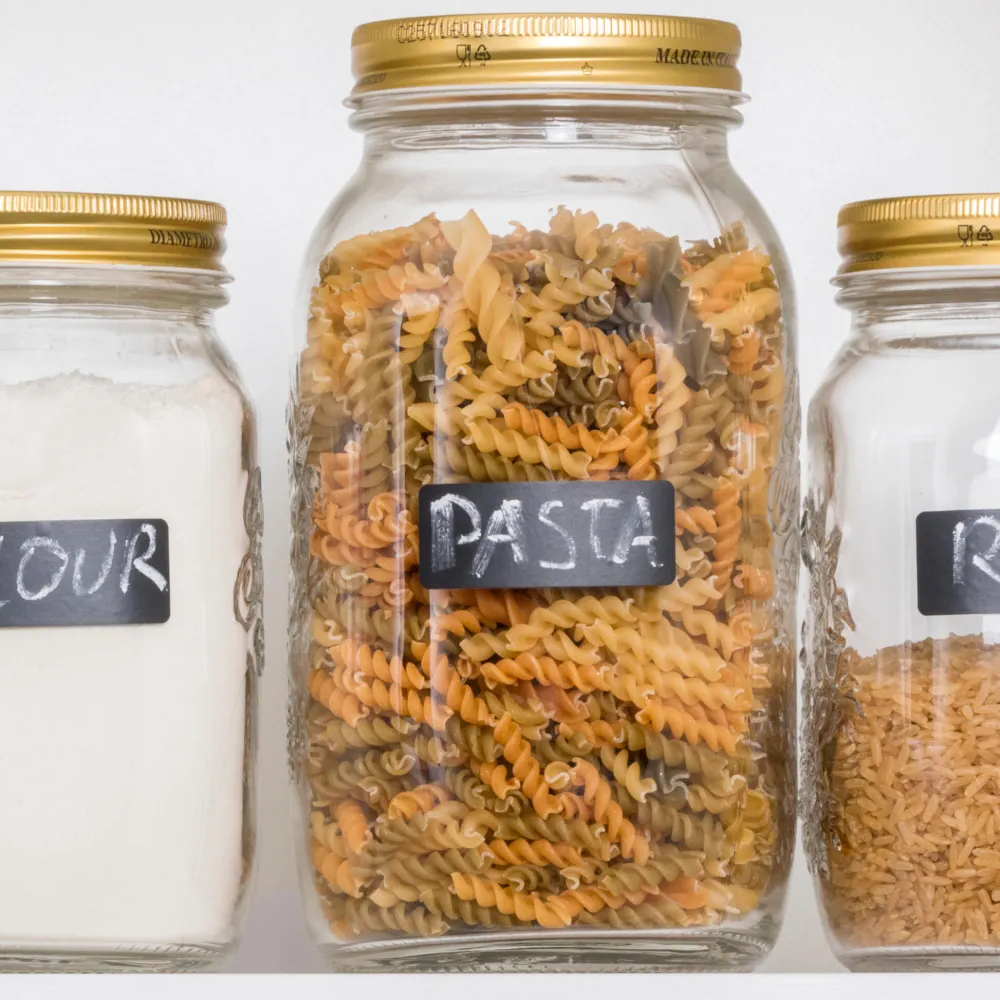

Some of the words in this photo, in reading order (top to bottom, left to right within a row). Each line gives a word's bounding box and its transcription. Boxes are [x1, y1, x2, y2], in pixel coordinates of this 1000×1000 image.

[655, 47, 700, 65] MADE
[701, 50, 716, 67] IN
[148, 229, 212, 249] DIAMETRO
[430, 492, 664, 578] PASTA
